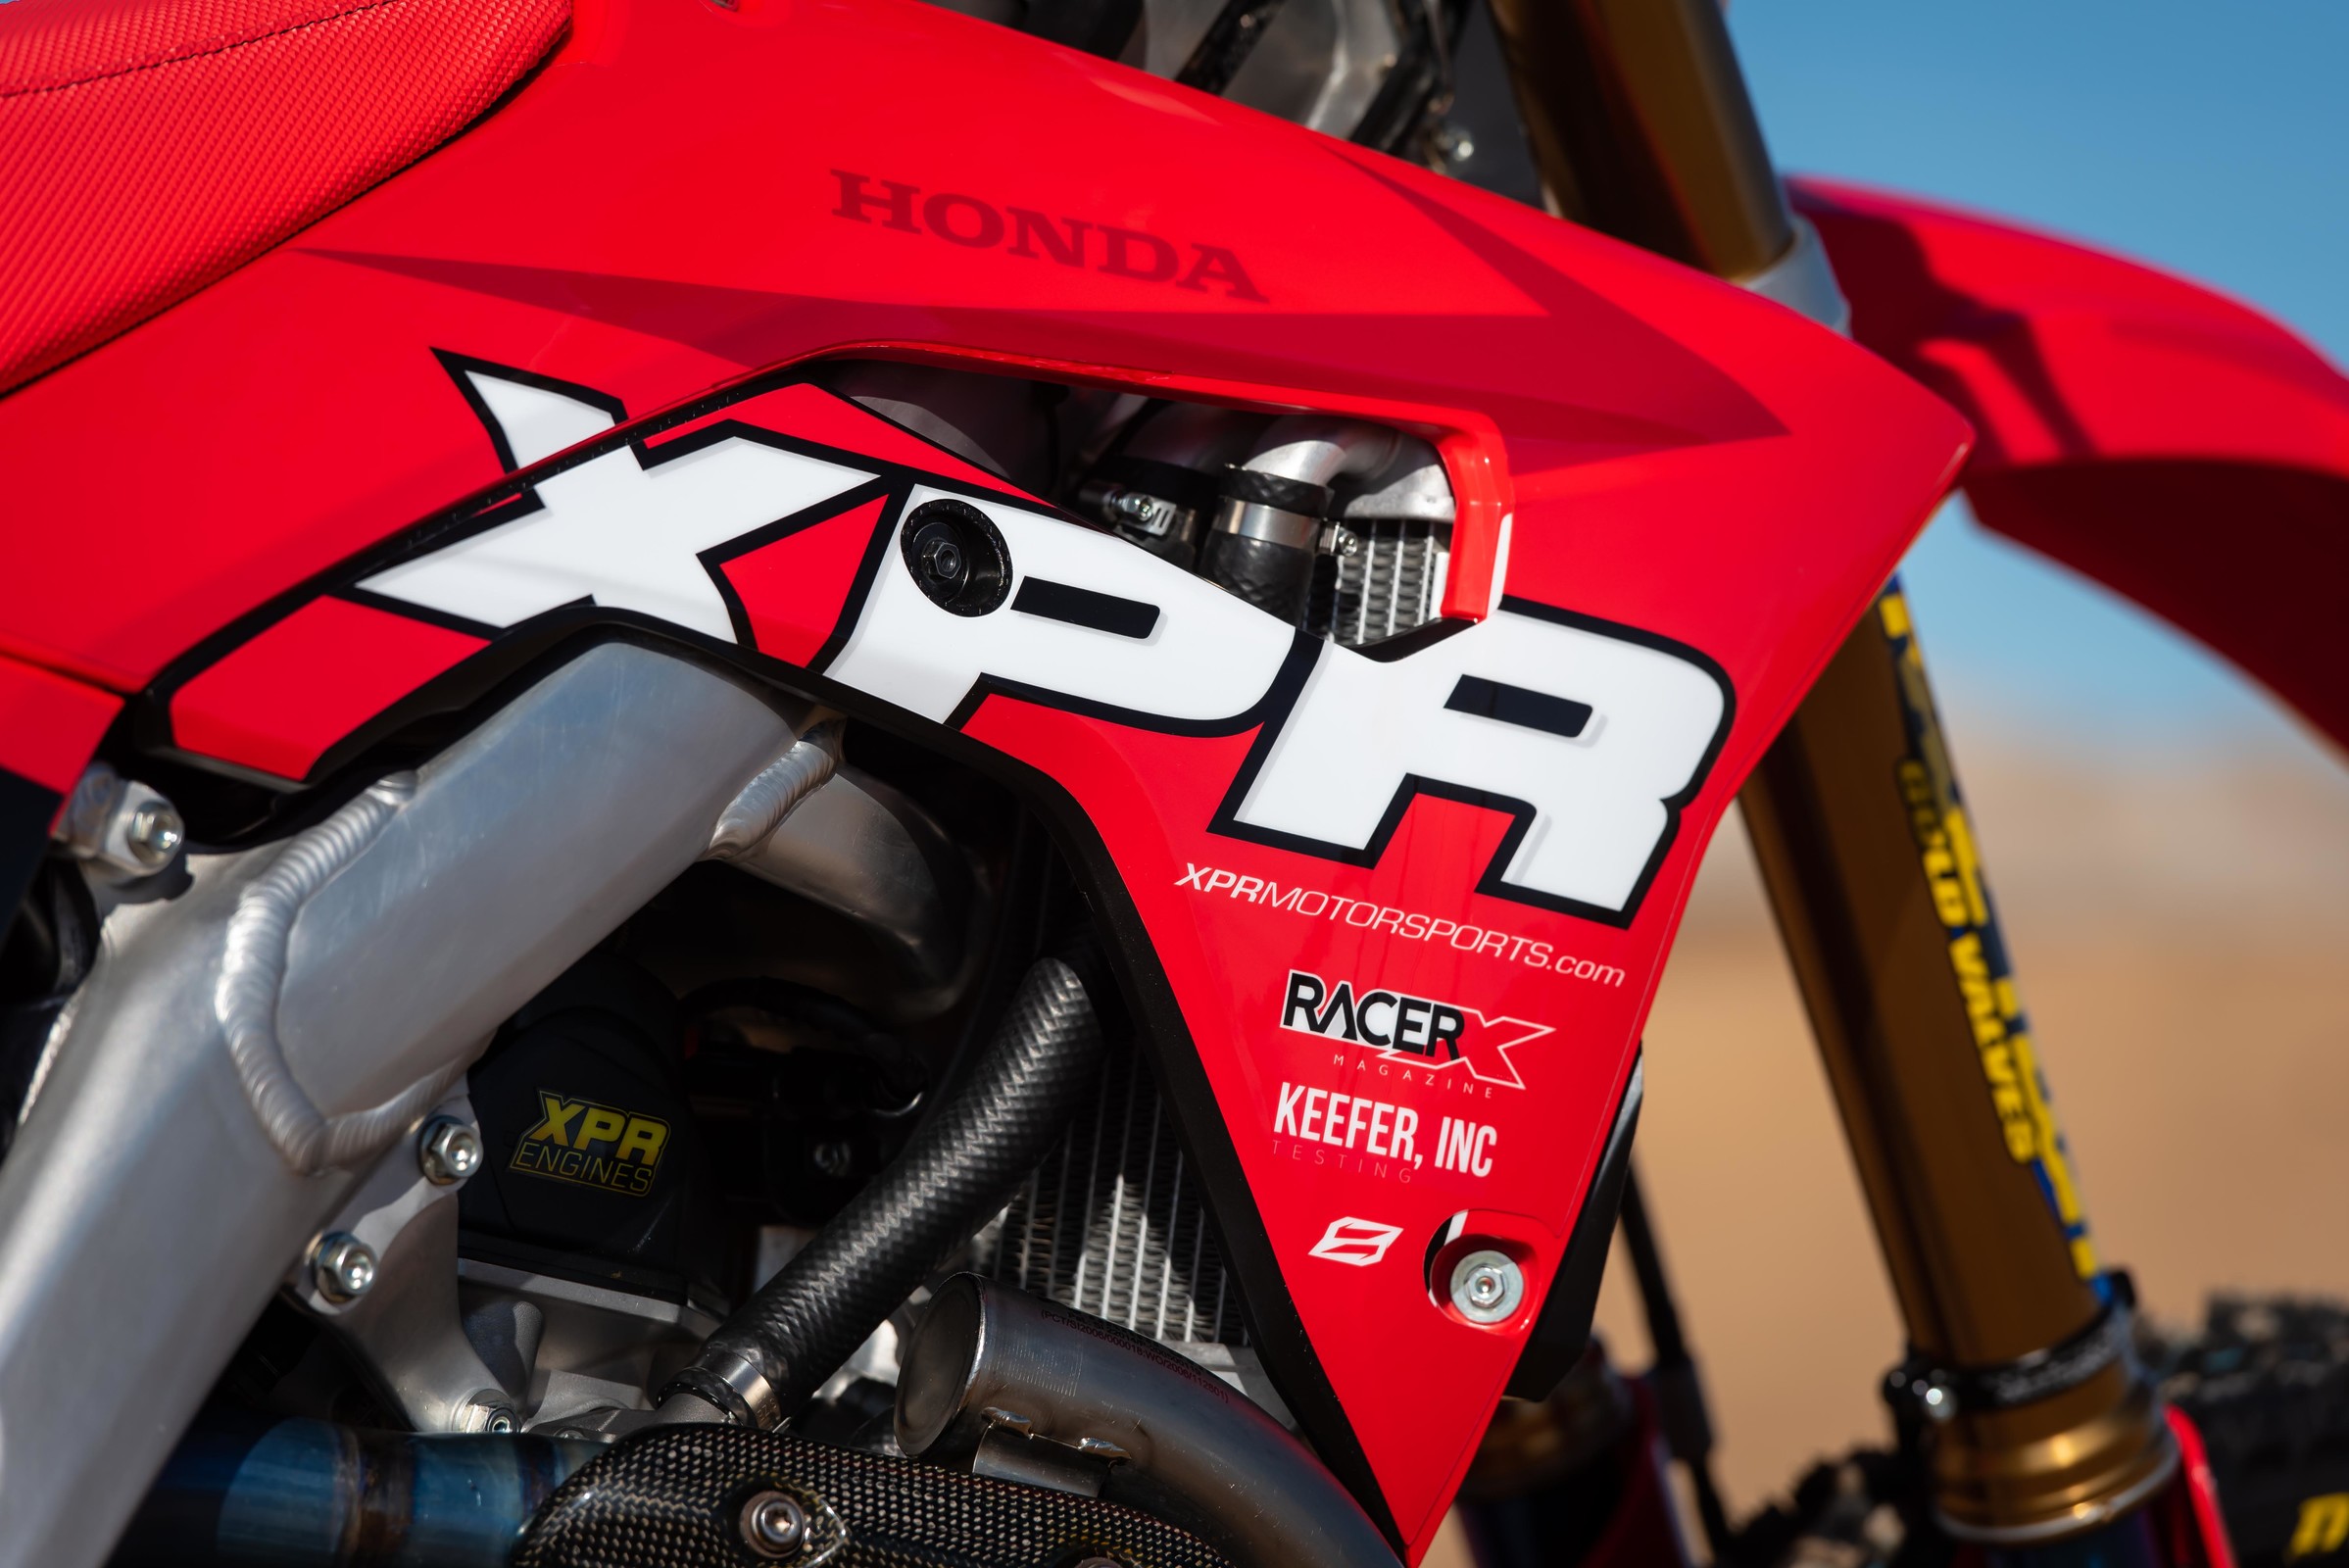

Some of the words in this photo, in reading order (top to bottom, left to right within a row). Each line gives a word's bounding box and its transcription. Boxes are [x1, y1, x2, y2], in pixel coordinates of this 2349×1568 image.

[829, 168, 1270, 304] HONDA
[345, 350, 1736, 930] XPR
[1174, 861, 1626, 988] XPRMOTORSPORTS.com
[1281, 970, 1466, 1062] RACER
[1333, 1053, 1494, 1100] MAGAZINE
[515, 1141, 654, 1194] ENGINES
[529, 1096, 669, 1166] XPR
[1271, 1139, 1412, 1185] TESTING
[1273, 1081, 1424, 1170] KEEFER,
[1434, 1116, 1498, 1178] INC
